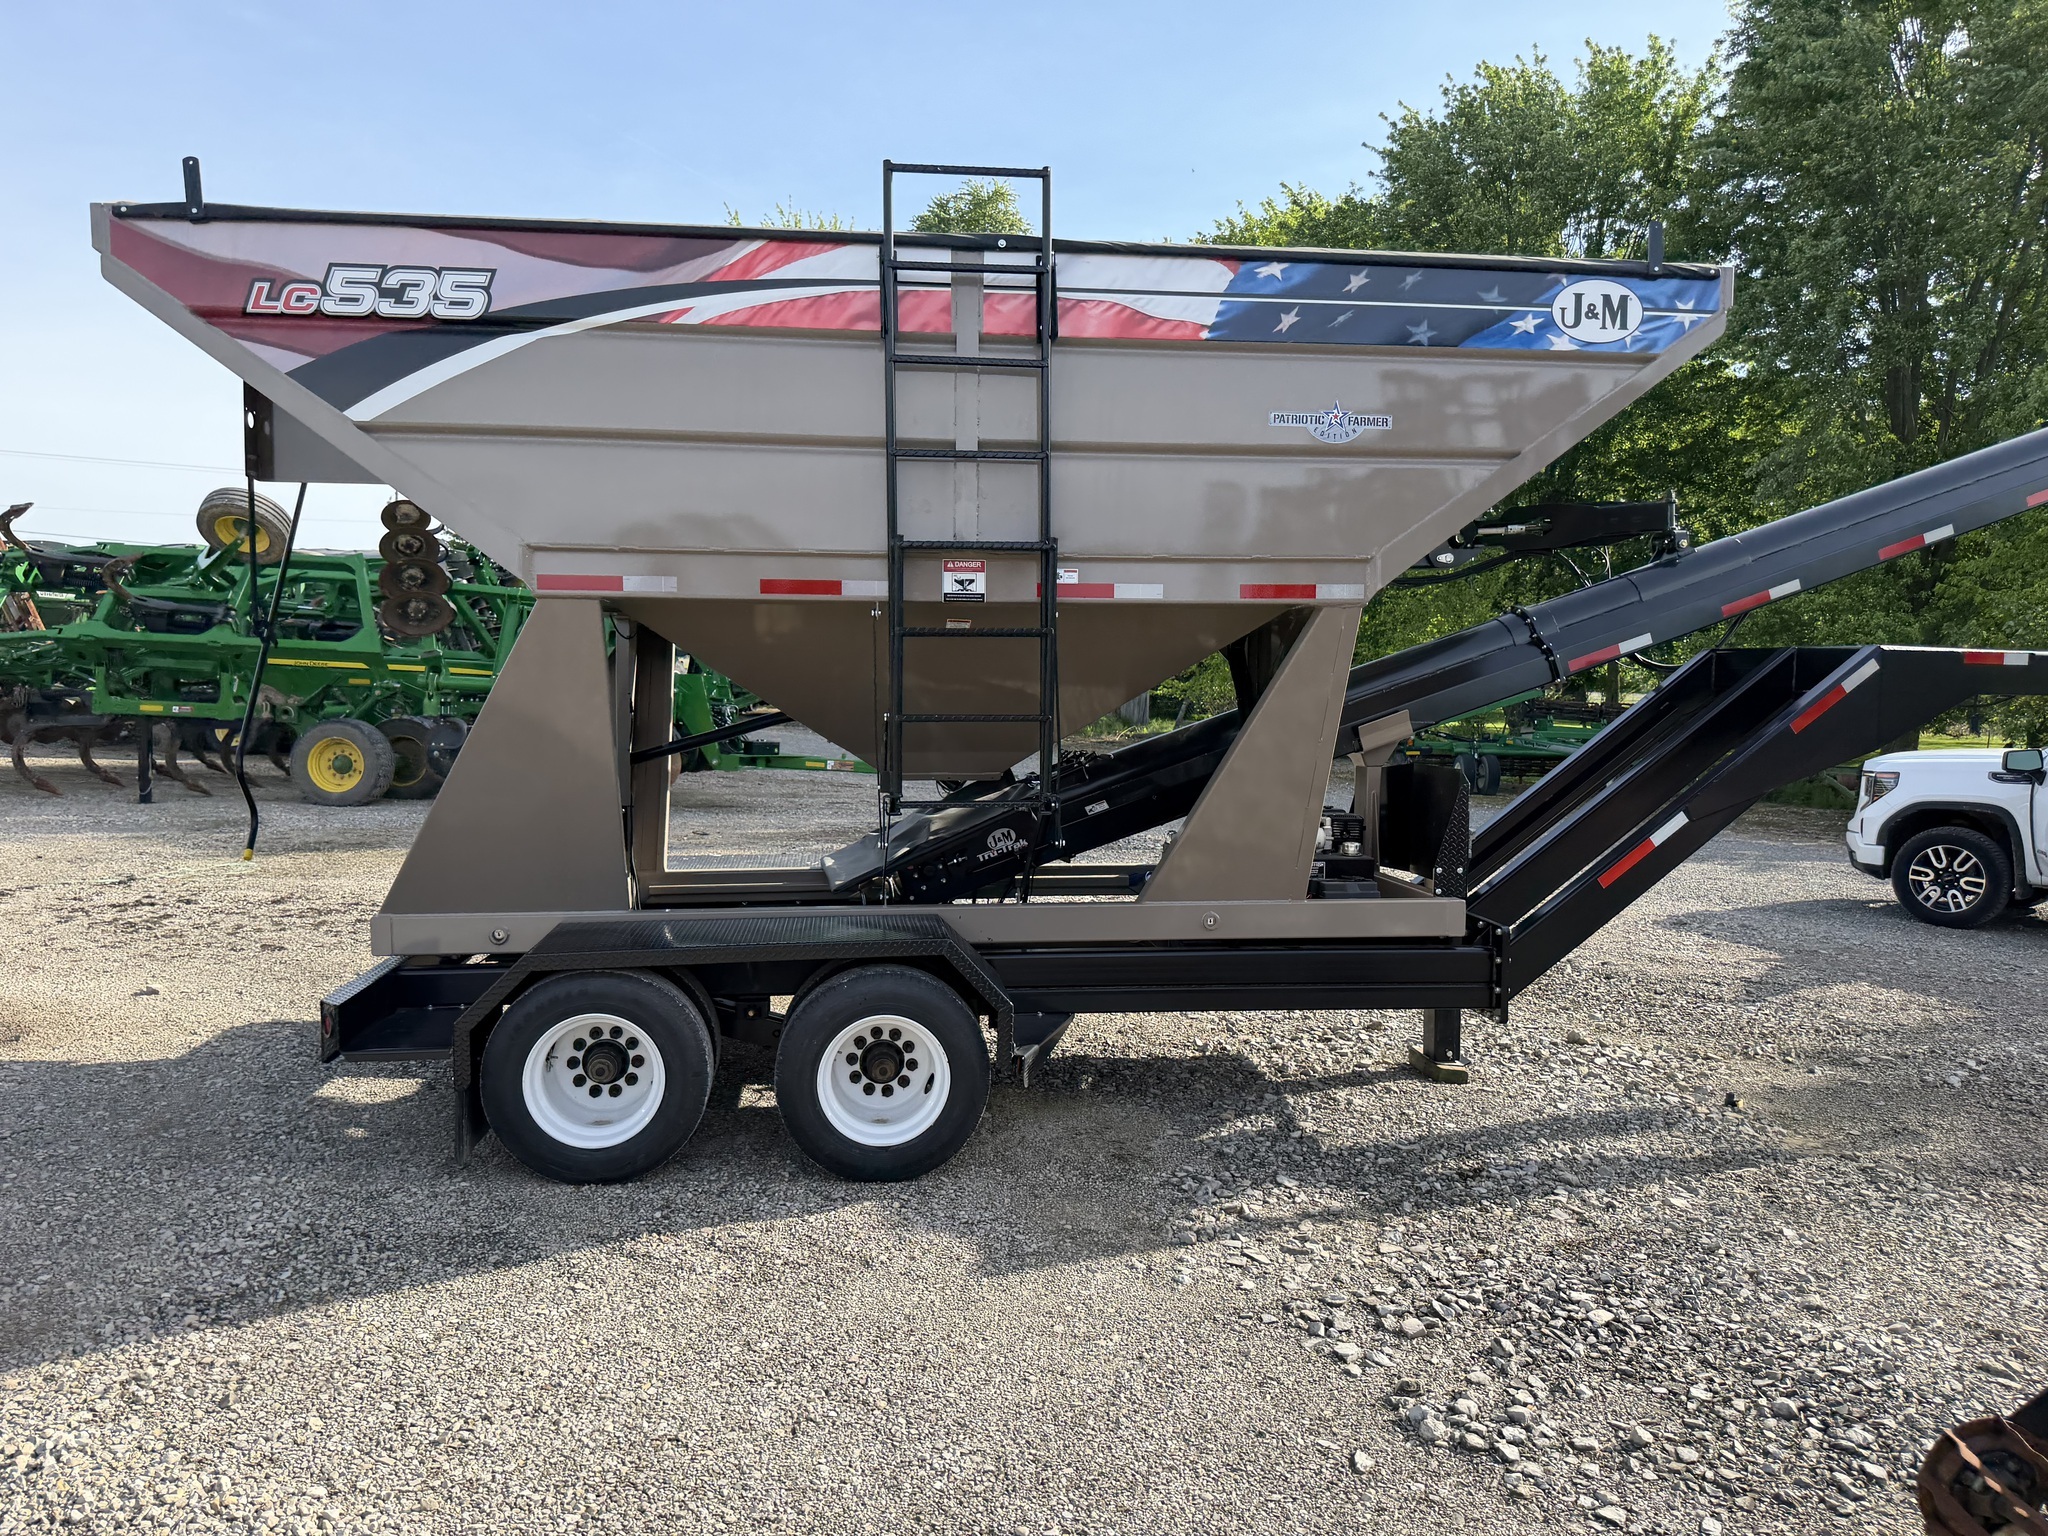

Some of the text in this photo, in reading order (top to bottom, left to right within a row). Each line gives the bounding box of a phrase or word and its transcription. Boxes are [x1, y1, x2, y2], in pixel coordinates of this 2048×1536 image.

[1559, 292, 1631, 331] J&M
[1273, 413, 1389, 427] PATRIOTIC FARMER
[1313, 426, 1358, 440] EDITION
[989, 829, 1014, 848] J&M
